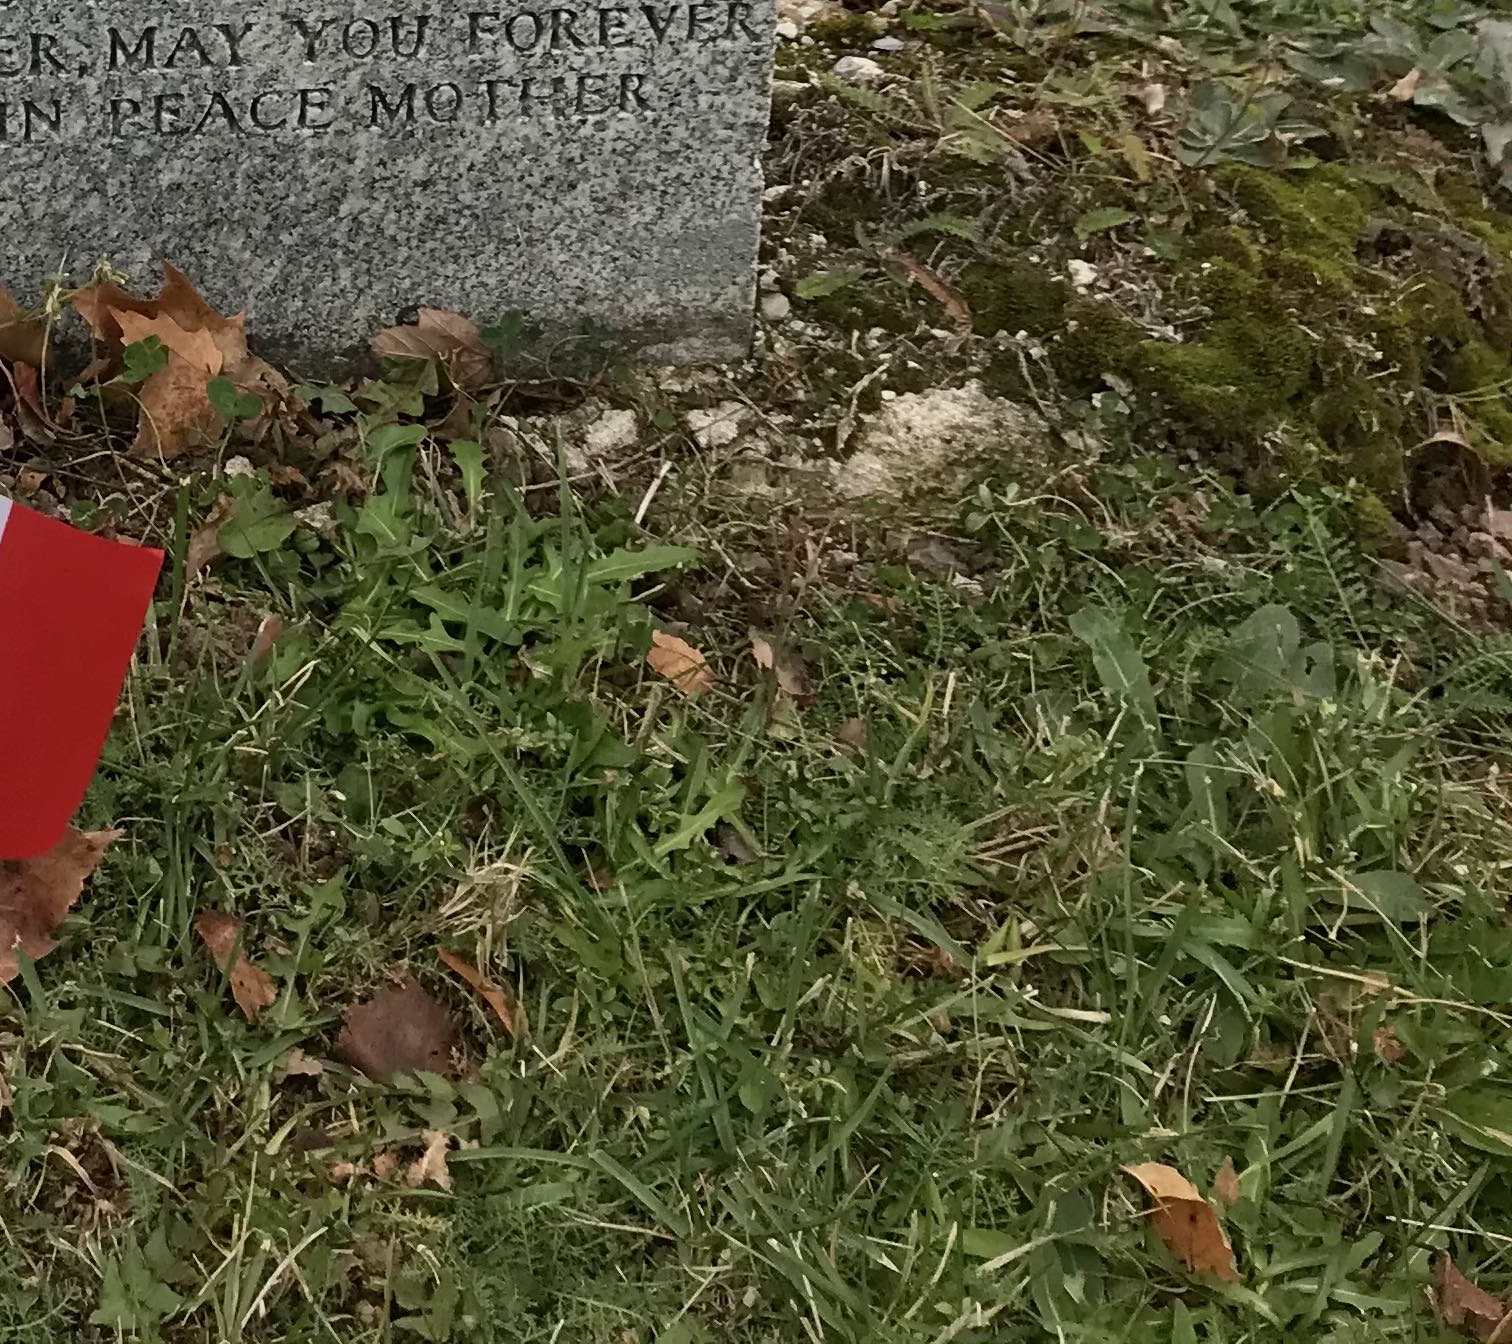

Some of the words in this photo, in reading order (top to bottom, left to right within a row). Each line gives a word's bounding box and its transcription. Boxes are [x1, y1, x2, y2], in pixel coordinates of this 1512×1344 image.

[107, 23, 254, 72] MAY
[292, 17, 428, 63] YOU
[468, 2, 762, 54] FOREVER
[108, 86, 333, 138] PEACE
[369, 72, 656, 128] MOTHER
